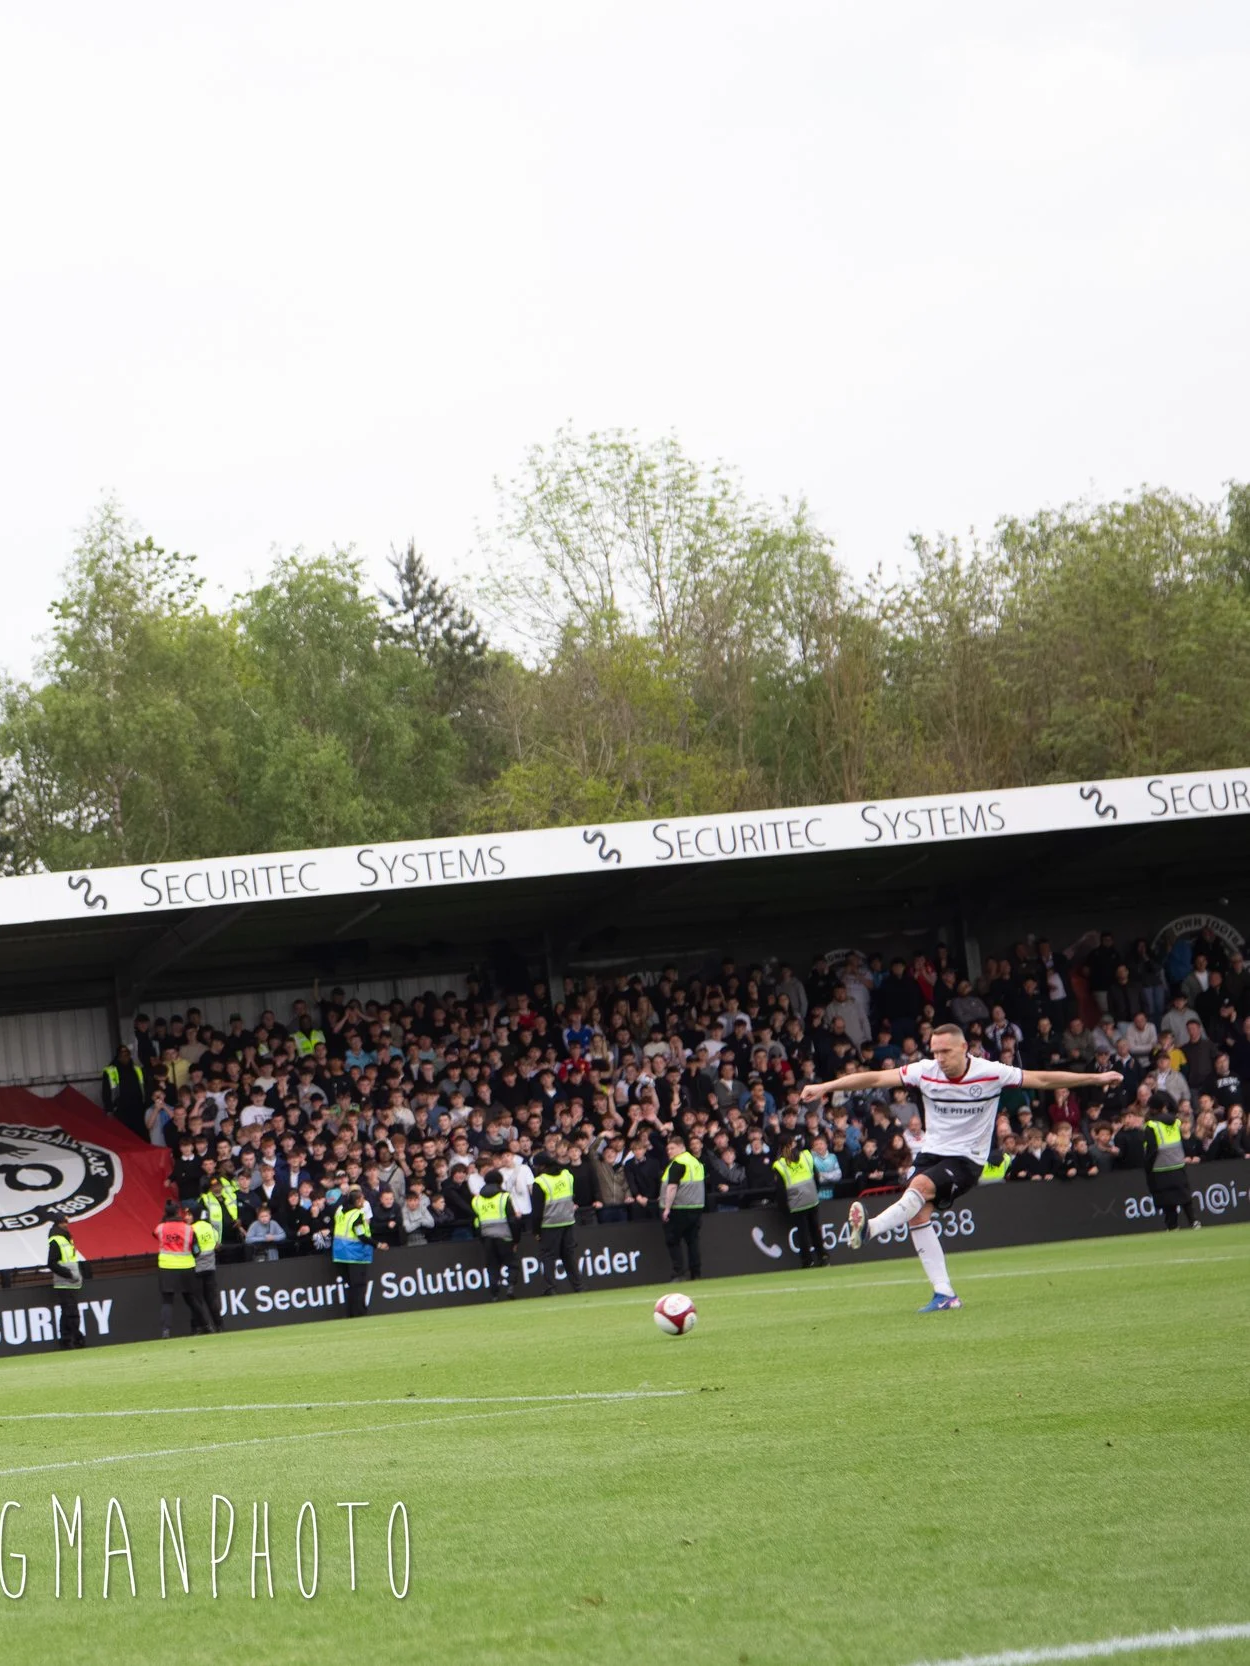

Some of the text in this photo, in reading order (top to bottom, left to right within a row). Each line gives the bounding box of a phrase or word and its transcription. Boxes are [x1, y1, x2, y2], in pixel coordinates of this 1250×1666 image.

[652, 804, 1005, 860] SECURITEC SYSTEMS
[140, 845, 506, 907] SECURITEC SYSTEMS
[933, 1104, 984, 1114] THE PITMEN
[1124, 1180, 1250, 1219] adn@i-
[254, 1276, 374, 1313] Securi
[521, 1246, 640, 1284] Poider
